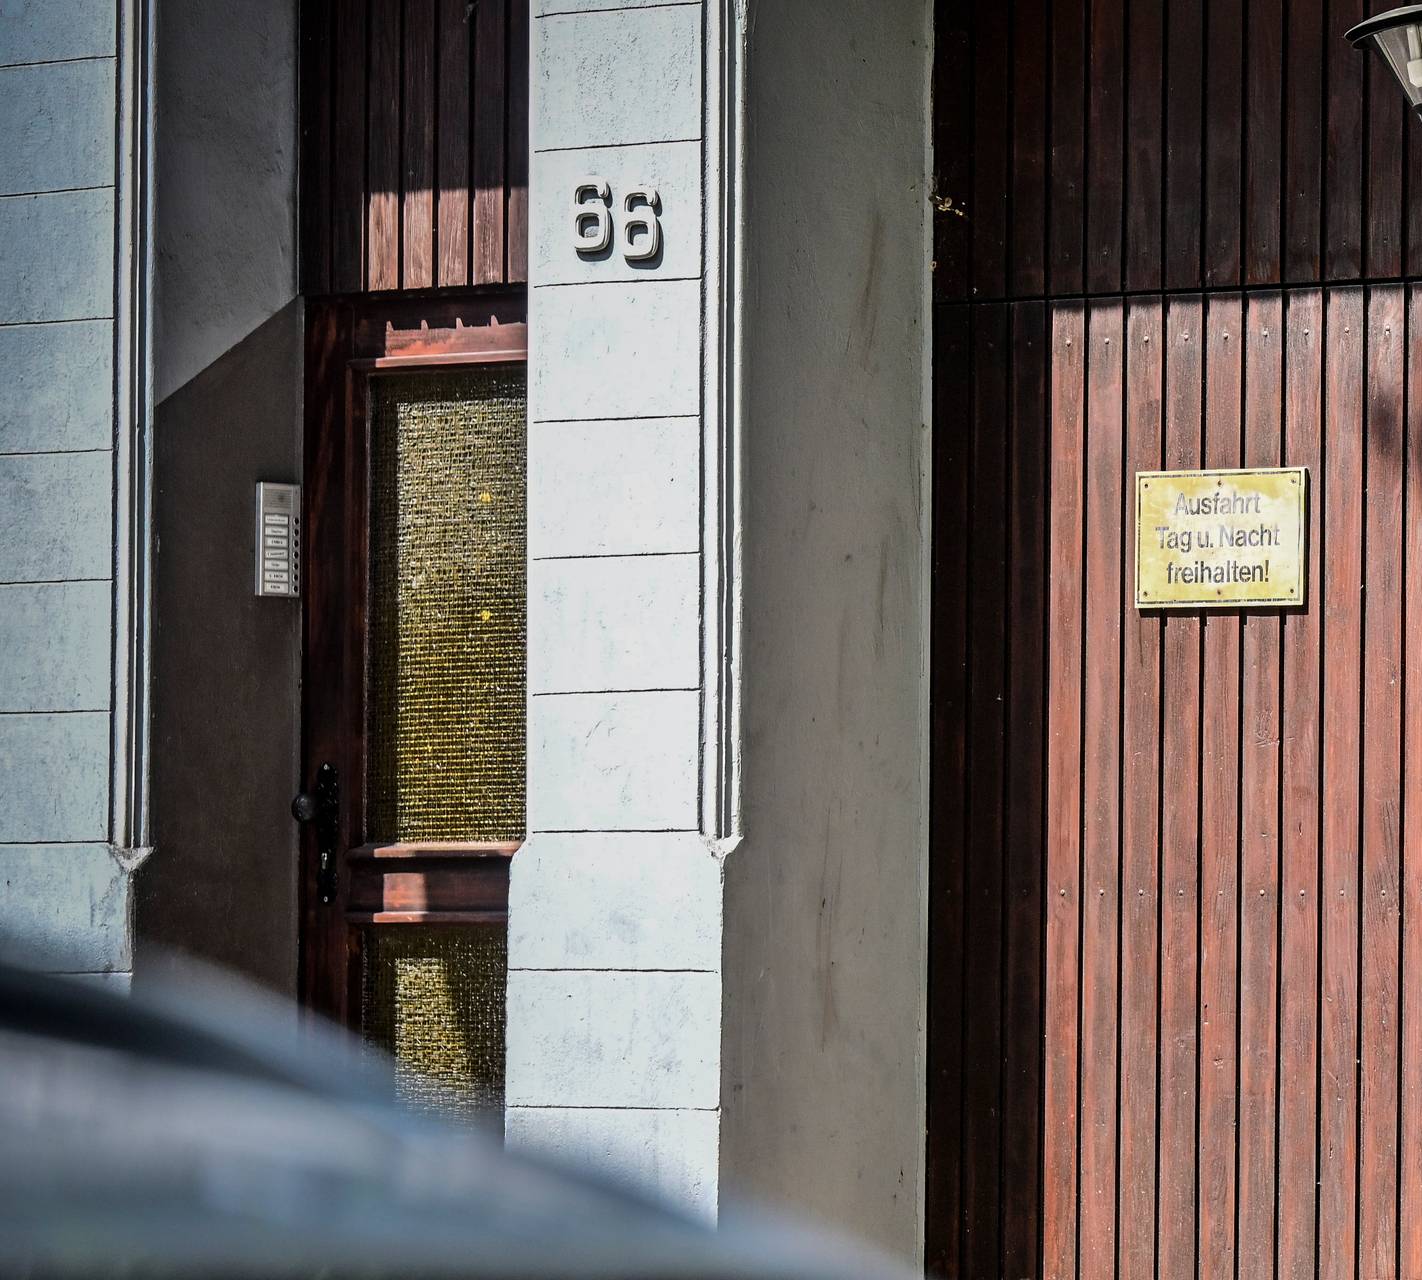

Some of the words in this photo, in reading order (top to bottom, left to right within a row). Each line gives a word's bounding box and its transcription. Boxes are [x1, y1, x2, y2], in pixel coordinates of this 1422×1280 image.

[570, 175, 661, 263] 66
[1175, 490, 1261, 516] Ausfahrt
[1155, 525, 1193, 553] Tag
[1197, 533, 1214, 549] u.
[1219, 523, 1281, 548] Nacht
[1166, 559, 1270, 584] freihalten!
